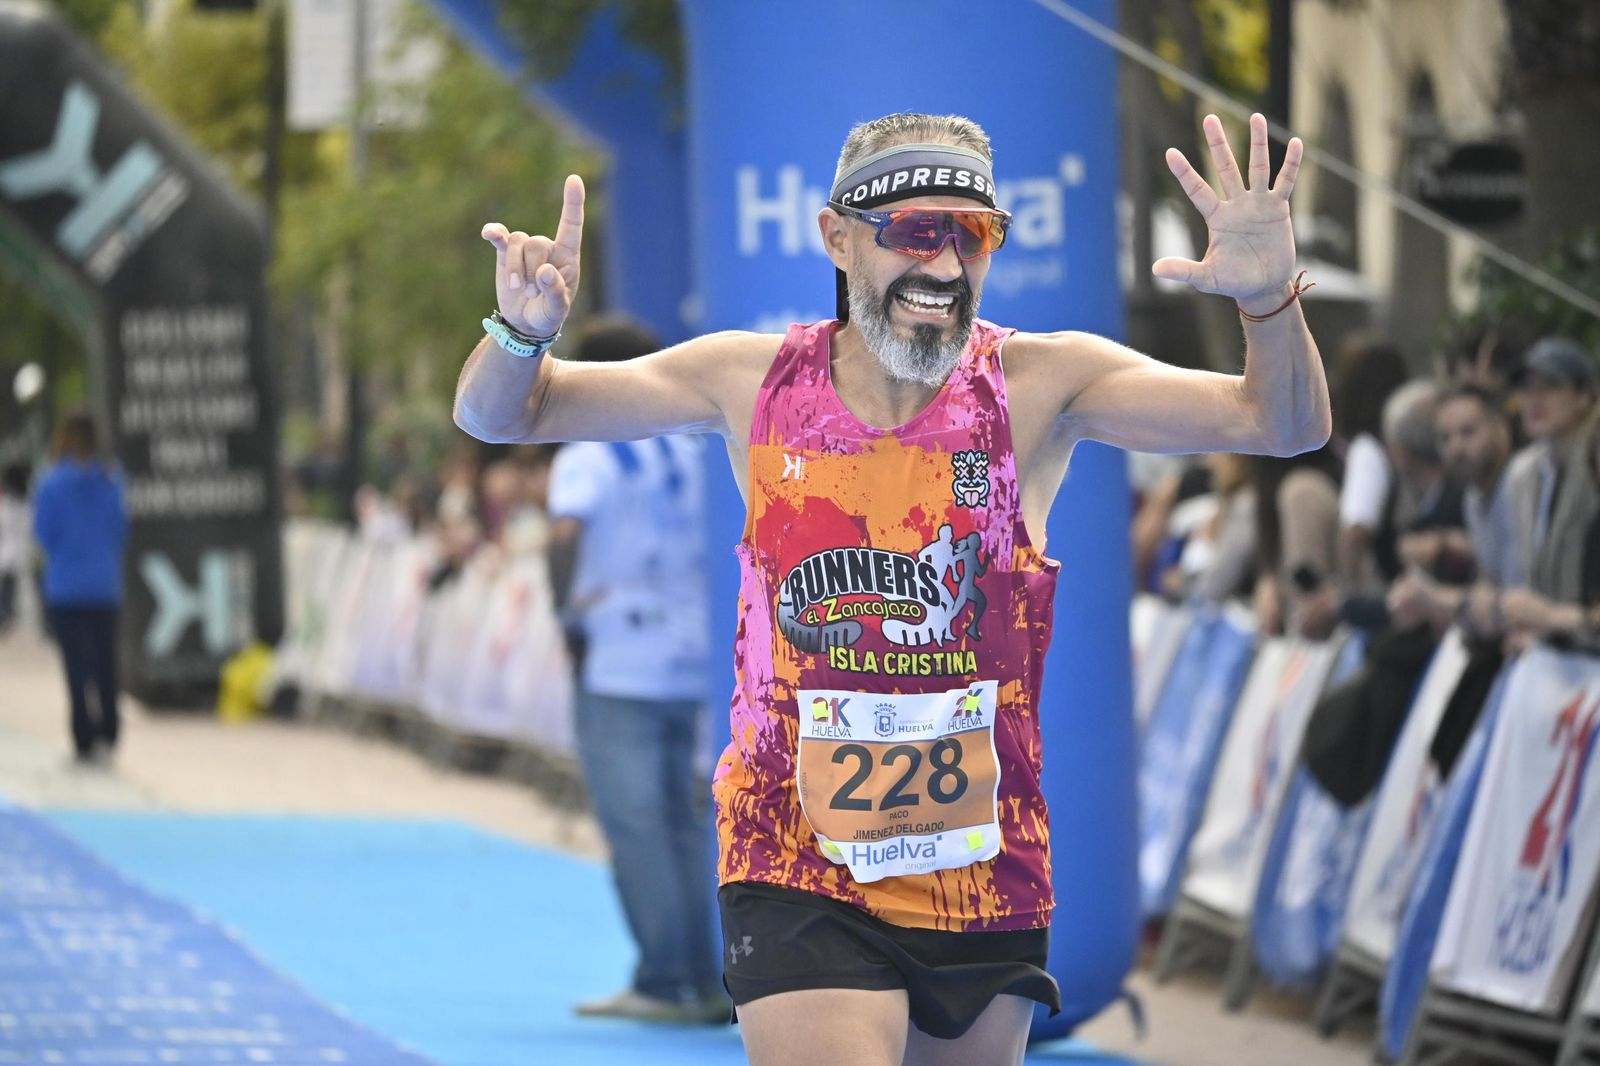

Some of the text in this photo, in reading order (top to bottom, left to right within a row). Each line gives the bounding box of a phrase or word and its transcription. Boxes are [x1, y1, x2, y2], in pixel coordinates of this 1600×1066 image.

[788, 549, 941, 617] RUNNERS
[822, 598, 921, 622] Zancajazo
[829, 647, 978, 676] ISLA CRISTINA
[812, 725, 852, 738] HUELVA
[898, 723, 934, 733] HUELVA
[947, 717, 983, 732] HUELVA
[829, 738, 968, 811] 228
[889, 811, 909, 820] PACO
[853, 821, 944, 840] JIMENEZ DELGADO
[852, 836, 938, 867] Huelva
[905, 860, 937, 870] original
